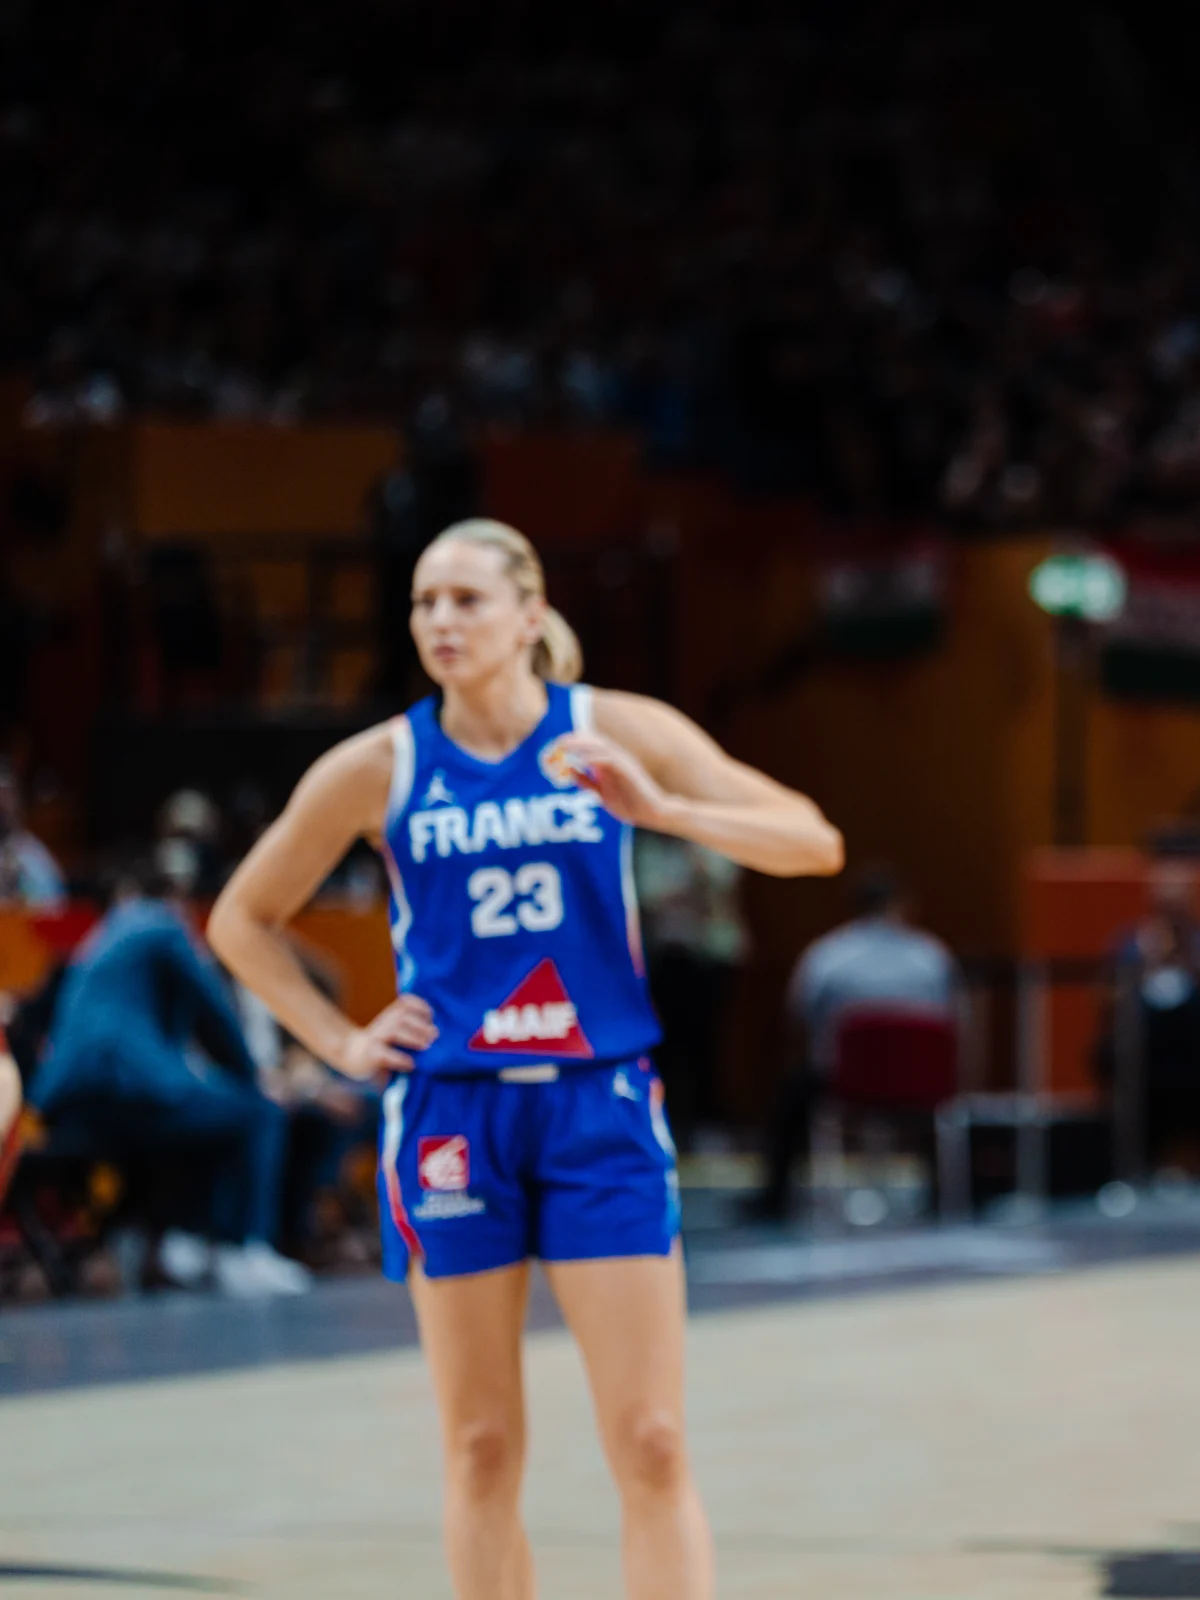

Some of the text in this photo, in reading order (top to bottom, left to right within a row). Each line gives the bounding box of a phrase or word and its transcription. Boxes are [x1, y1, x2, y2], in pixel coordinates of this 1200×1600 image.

[409, 792, 603, 863] FRANCE
[468, 863, 563, 937] 23
[483, 1002, 576, 1043] MAIF
